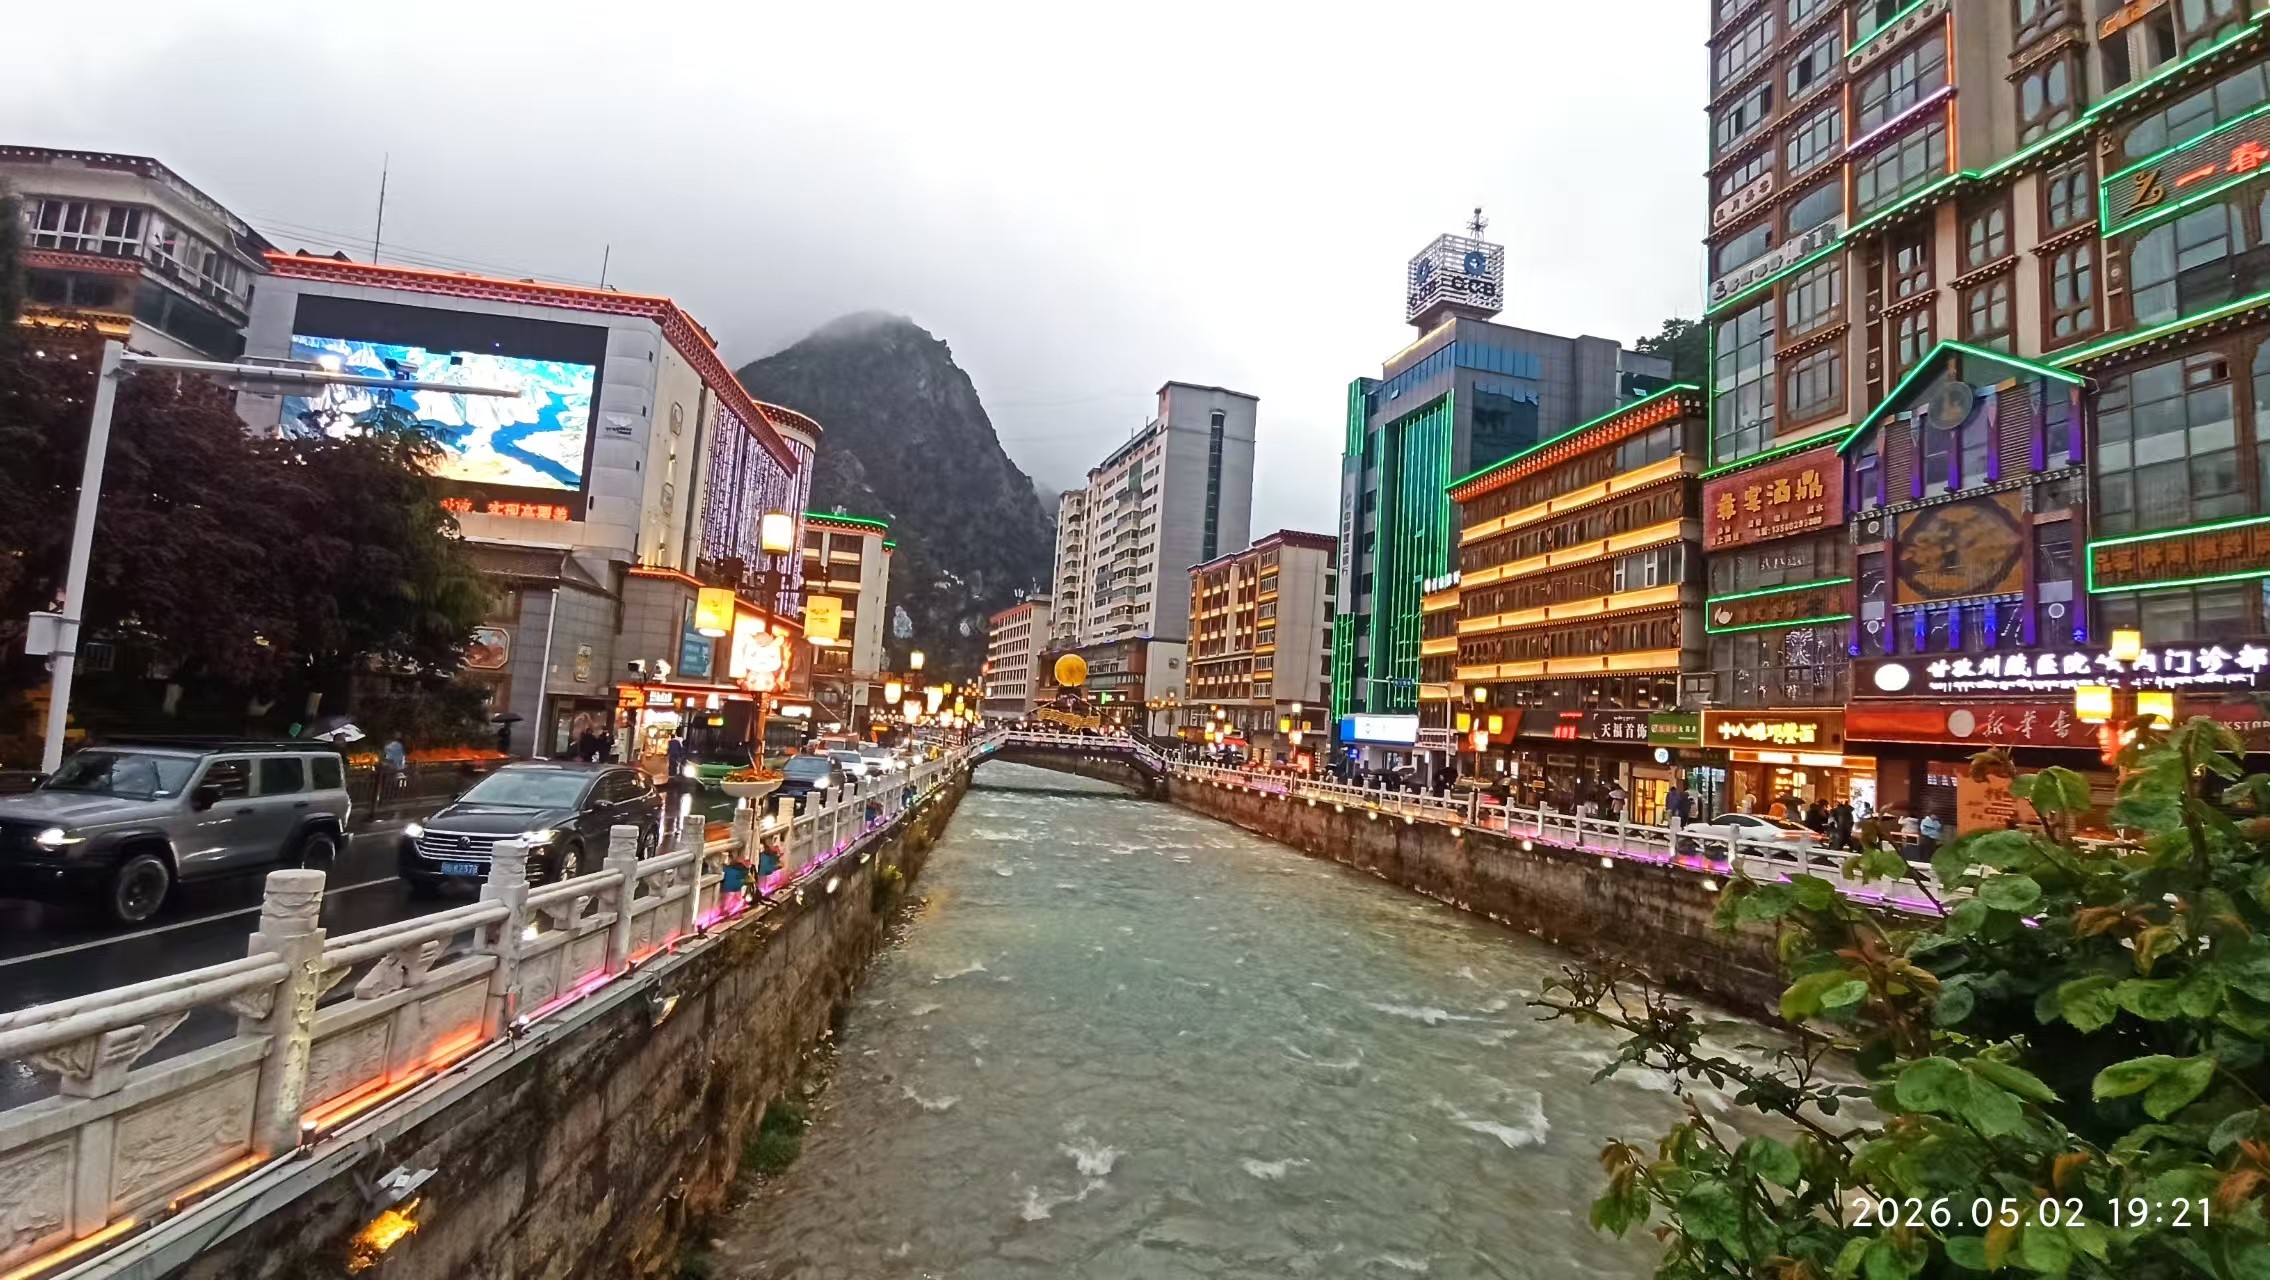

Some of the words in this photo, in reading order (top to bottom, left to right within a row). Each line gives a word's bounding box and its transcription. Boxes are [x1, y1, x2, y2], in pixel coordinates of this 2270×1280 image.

[1451, 276, 1496, 297] CCB
[1601, 722, 1648, 740] 天福首饰
